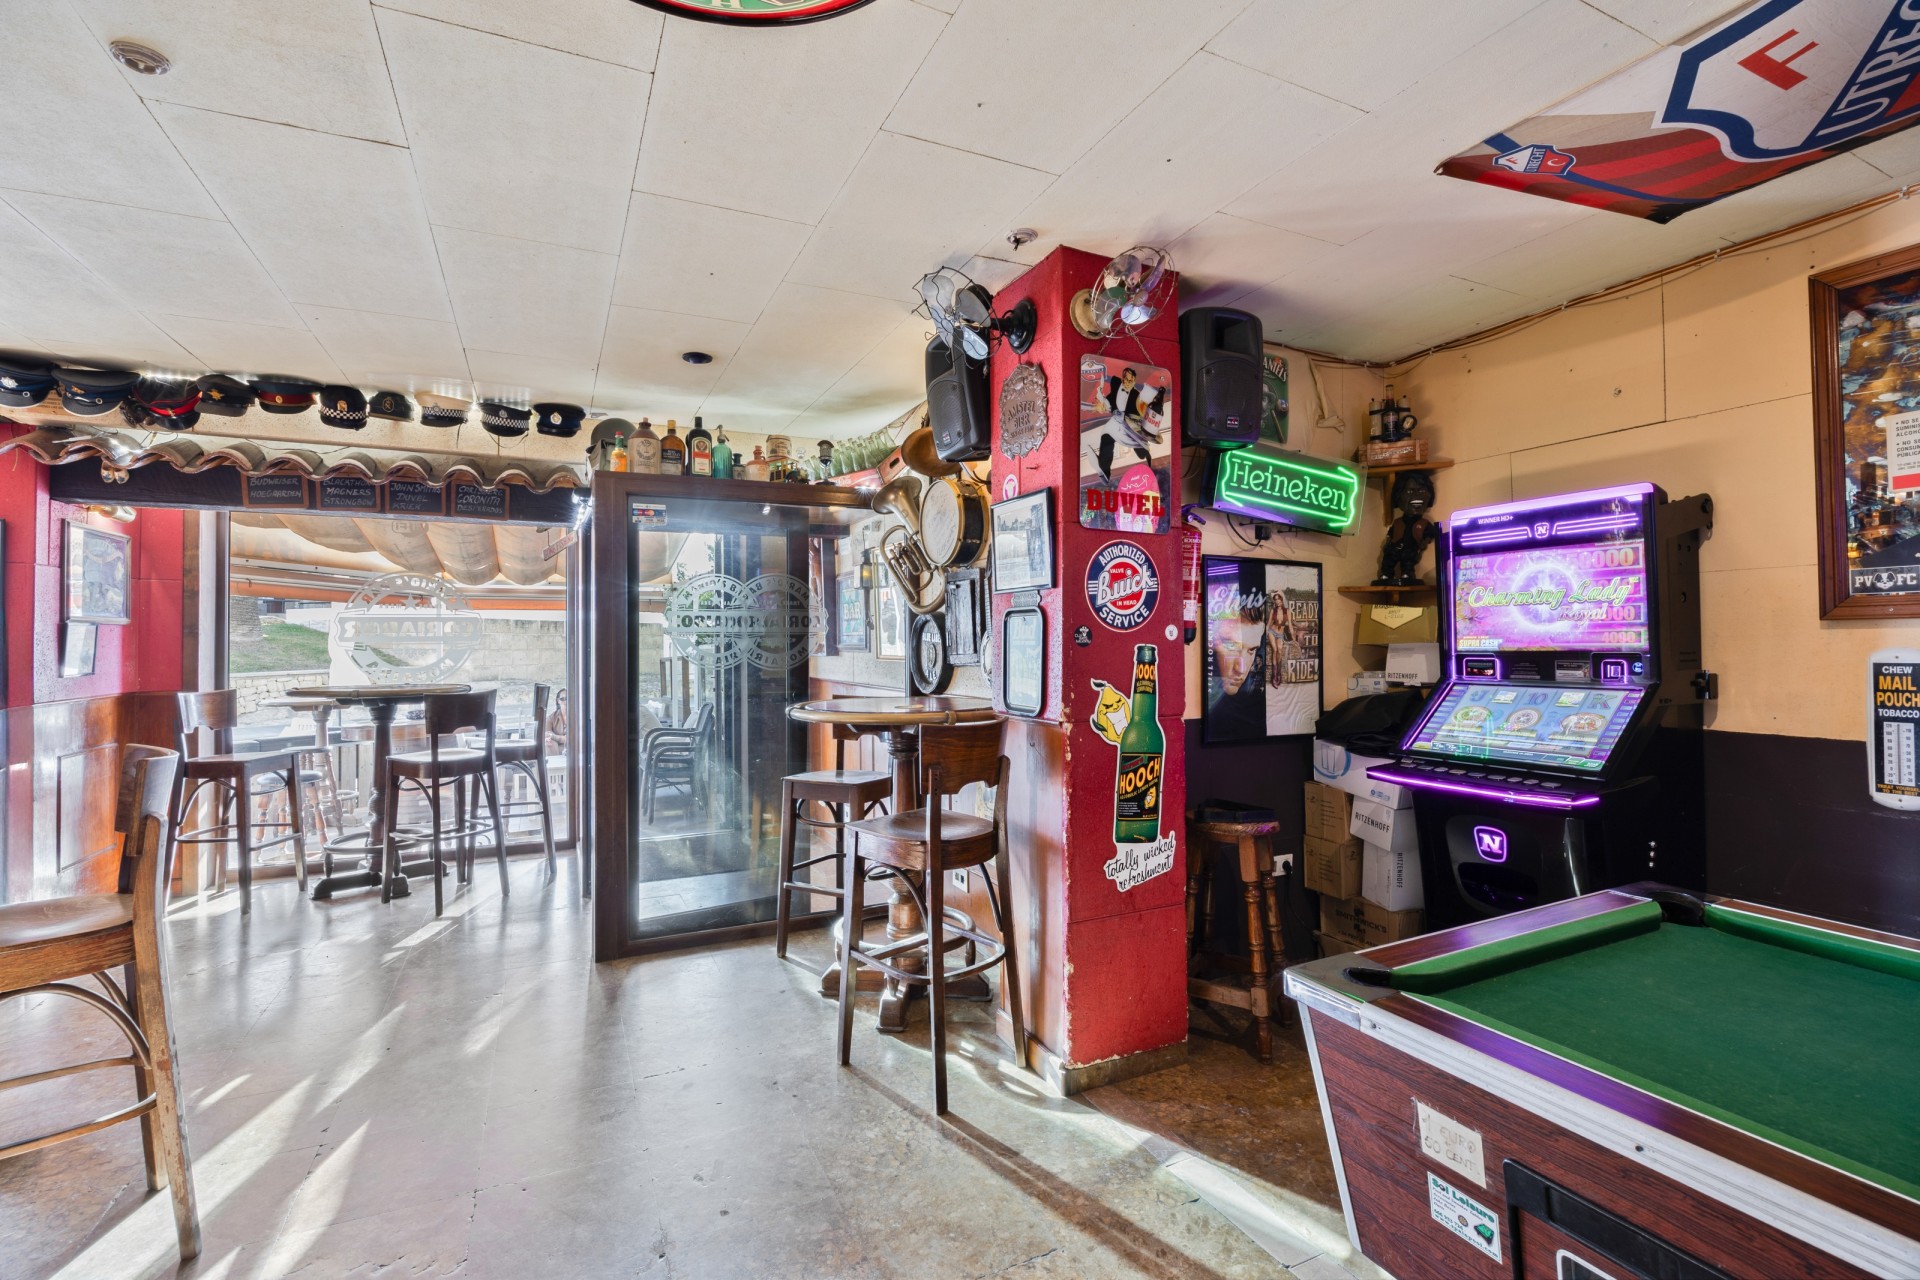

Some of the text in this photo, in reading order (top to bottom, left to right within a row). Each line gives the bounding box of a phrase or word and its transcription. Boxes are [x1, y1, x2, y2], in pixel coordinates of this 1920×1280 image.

[1737, 28, 1819, 91] F
[1264, 357, 1288, 383] ANIEL'S
[326, 488, 372, 496] MAGNERS
[1231, 458, 1347, 511] Heineken
[1087, 488, 1165, 517] DUVEL
[1478, 516, 1501, 525] WINNER
[1099, 545, 1146, 567] AUTHORIZED
[1096, 563, 1154, 608] Buick
[1855, 573, 1917, 587] PV FC
[1209, 584, 1266, 618] Elvis
[1468, 576, 1632, 610] Charming Lady
[843, 602, 861, 619] BAR
[1099, 605, 1149, 628] SERVICE
[1289, 601, 1319, 620] READY
[1557, 602, 1608, 625] Royal
[1304, 634, 1318, 646] TO
[1288, 659, 1319, 683] RIDE!
[1879, 676, 1917, 690] MAIL
[1876, 692, 1920, 708] POUCH
[1878, 709, 1920, 718] TOBACCO
[1120, 757, 1161, 794] HOOCH
[1355, 812, 1391, 834] RITZENHOFF
[1105, 834, 1175, 879] totally wicked
[1119, 853, 1175, 891] refreshment
[1424, 1135, 1441, 1155] 50
[1440, 1125, 1477, 1153] EURO
[1432, 1178, 1495, 1223] Sol Leisure
